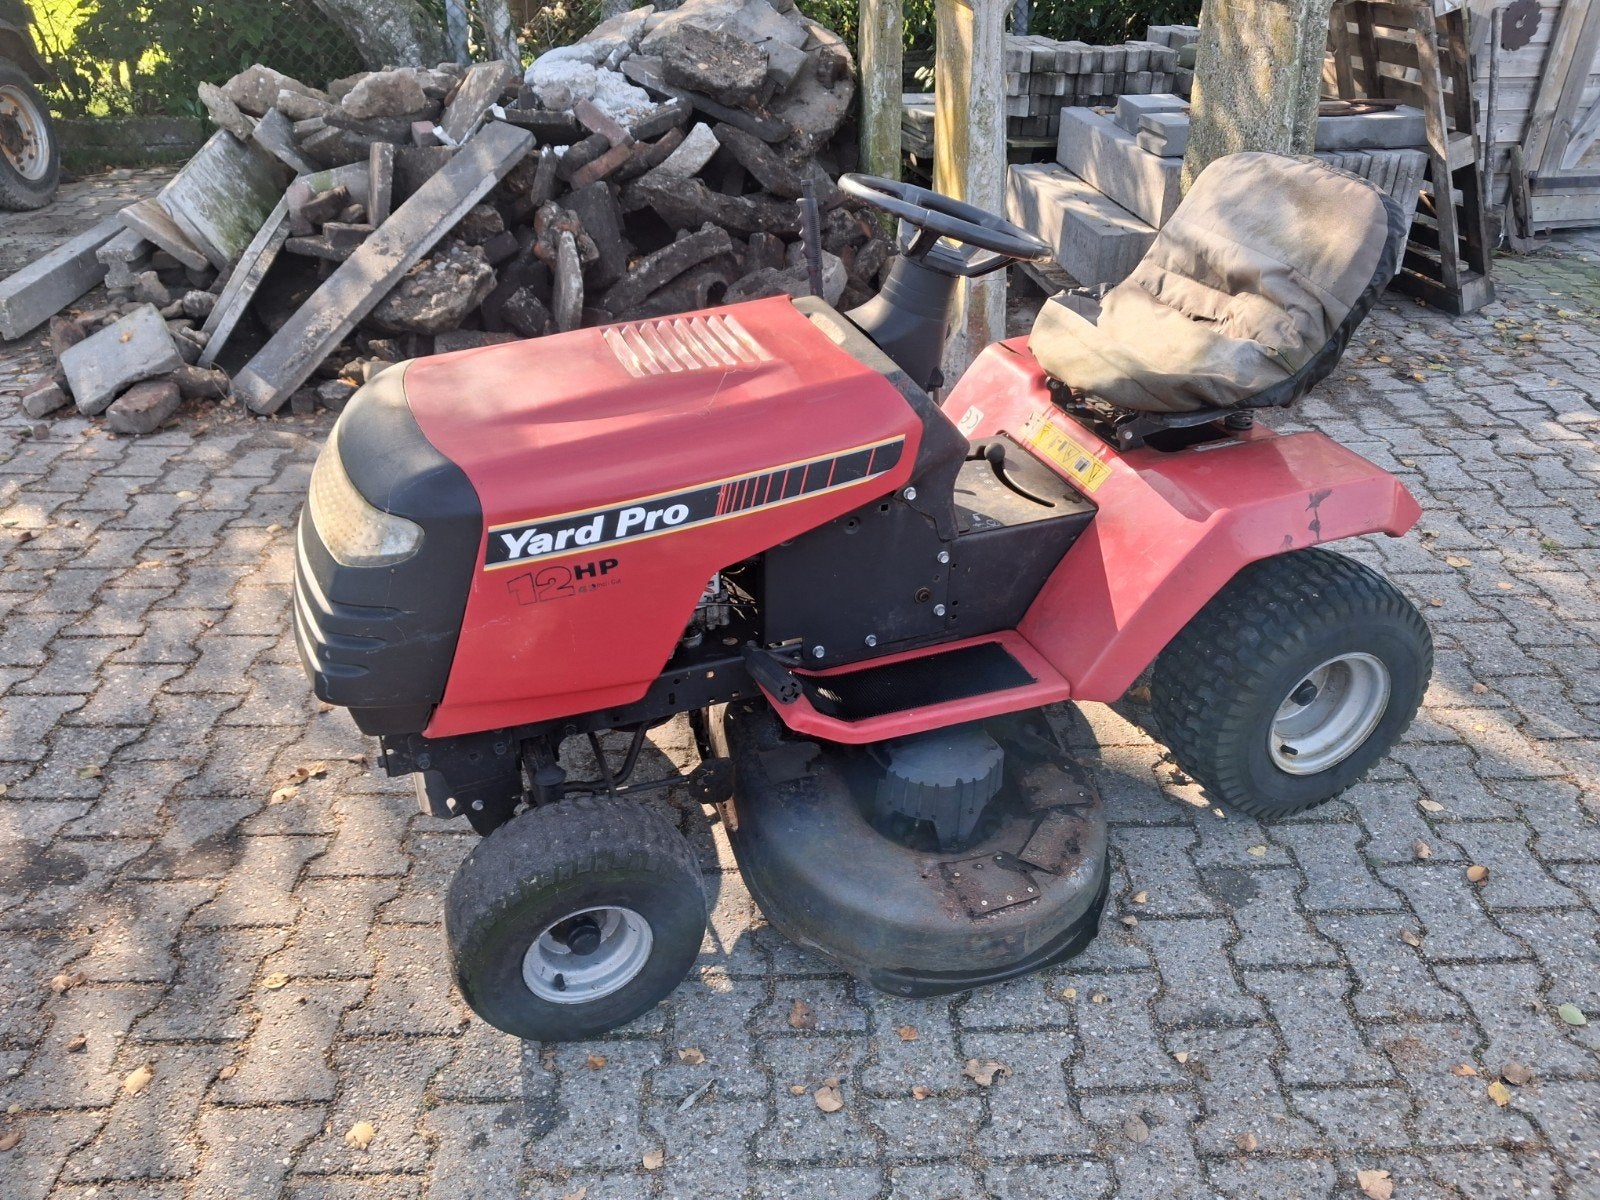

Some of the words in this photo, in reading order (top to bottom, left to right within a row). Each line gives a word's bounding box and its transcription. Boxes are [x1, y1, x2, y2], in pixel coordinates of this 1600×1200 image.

[500, 515, 604, 559] Yard
[615, 503, 690, 538] Pro
[506, 565, 576, 606] 12
[574, 558, 618, 580] HP
